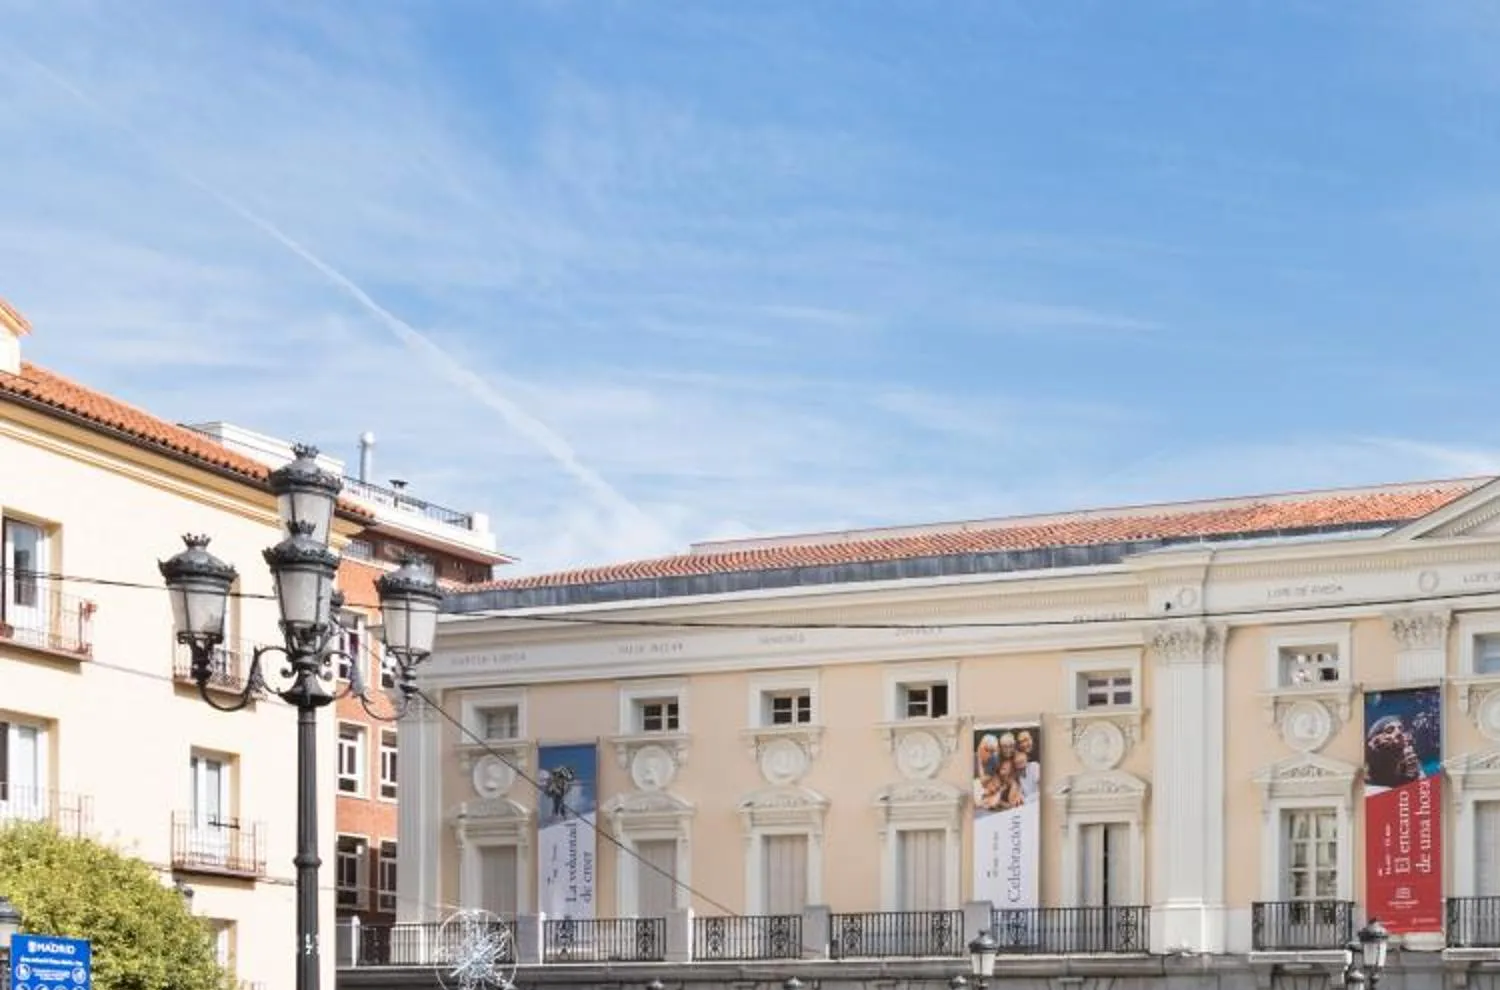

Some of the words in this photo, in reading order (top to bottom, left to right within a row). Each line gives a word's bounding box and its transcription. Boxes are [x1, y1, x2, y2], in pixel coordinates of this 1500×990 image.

[1415, 780, 1431, 816] hora
[1397, 791, 1411, 853] encanto
[1420, 819, 1431, 850] una
[1007, 814, 1022, 903] Celebración
[1394, 856, 1411, 874] El
[1415, 853, 1431, 873] de
[564, 885, 577, 903] La
[579, 885, 593, 904] de
[37, 943, 76, 955] MADRID
